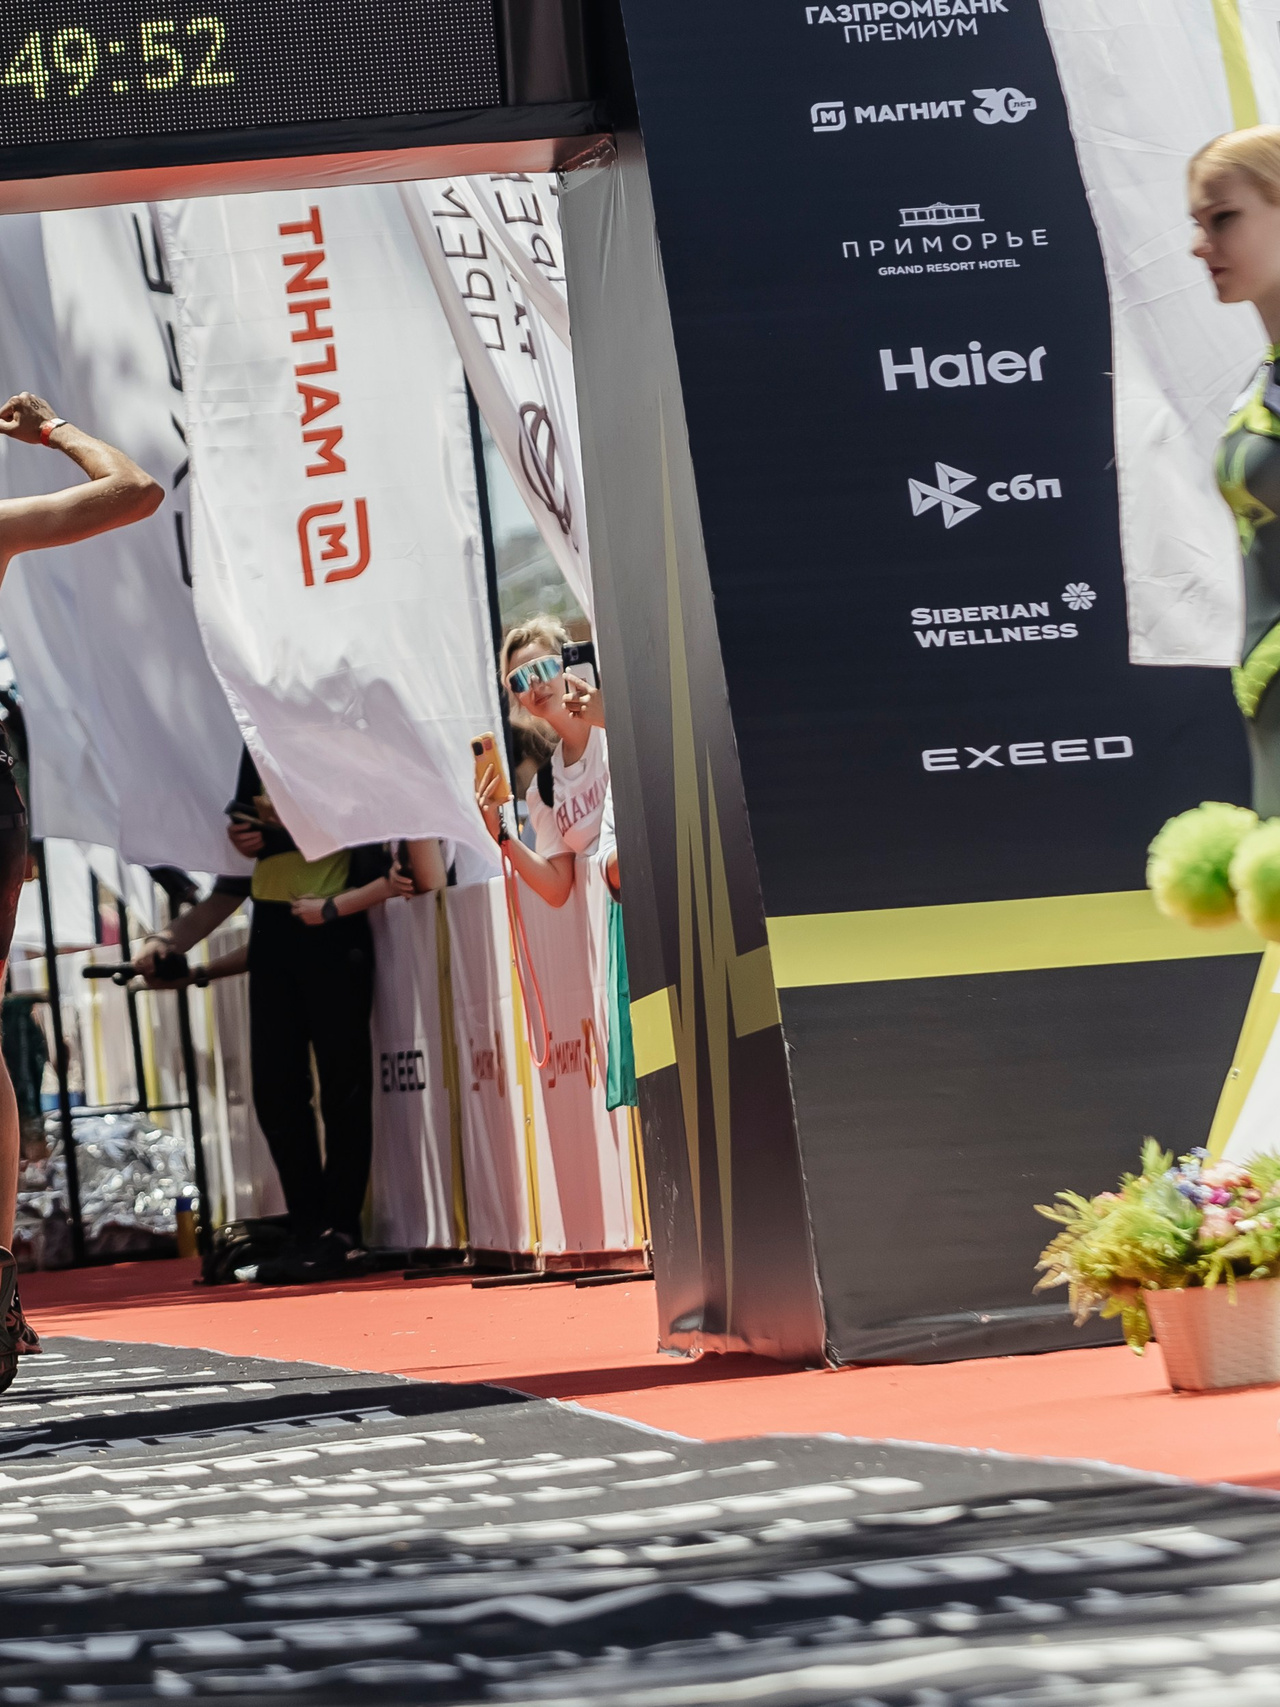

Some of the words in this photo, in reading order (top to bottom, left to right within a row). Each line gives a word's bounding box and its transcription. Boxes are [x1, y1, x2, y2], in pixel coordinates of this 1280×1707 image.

[805, 0, 1009, 24] ГАЗПРОМБАНК
[844, 18, 978, 43] ПРЕМИУМ
[854, 100, 966, 124] МАГНИТ
[842, 228, 1050, 259] ПРИМОРЬЕ
[878, 264, 924, 276] GRAND
[926, 261, 976, 273] RESORT
[978, 258, 1020, 270] HOTEL
[879, 340, 1047, 391] Haier
[987, 473, 1062, 502] сбп
[910, 601, 1050, 625] SIBERIAN
[913, 622, 1079, 648] WELLNESS
[922, 735, 1133, 771] EXEED
